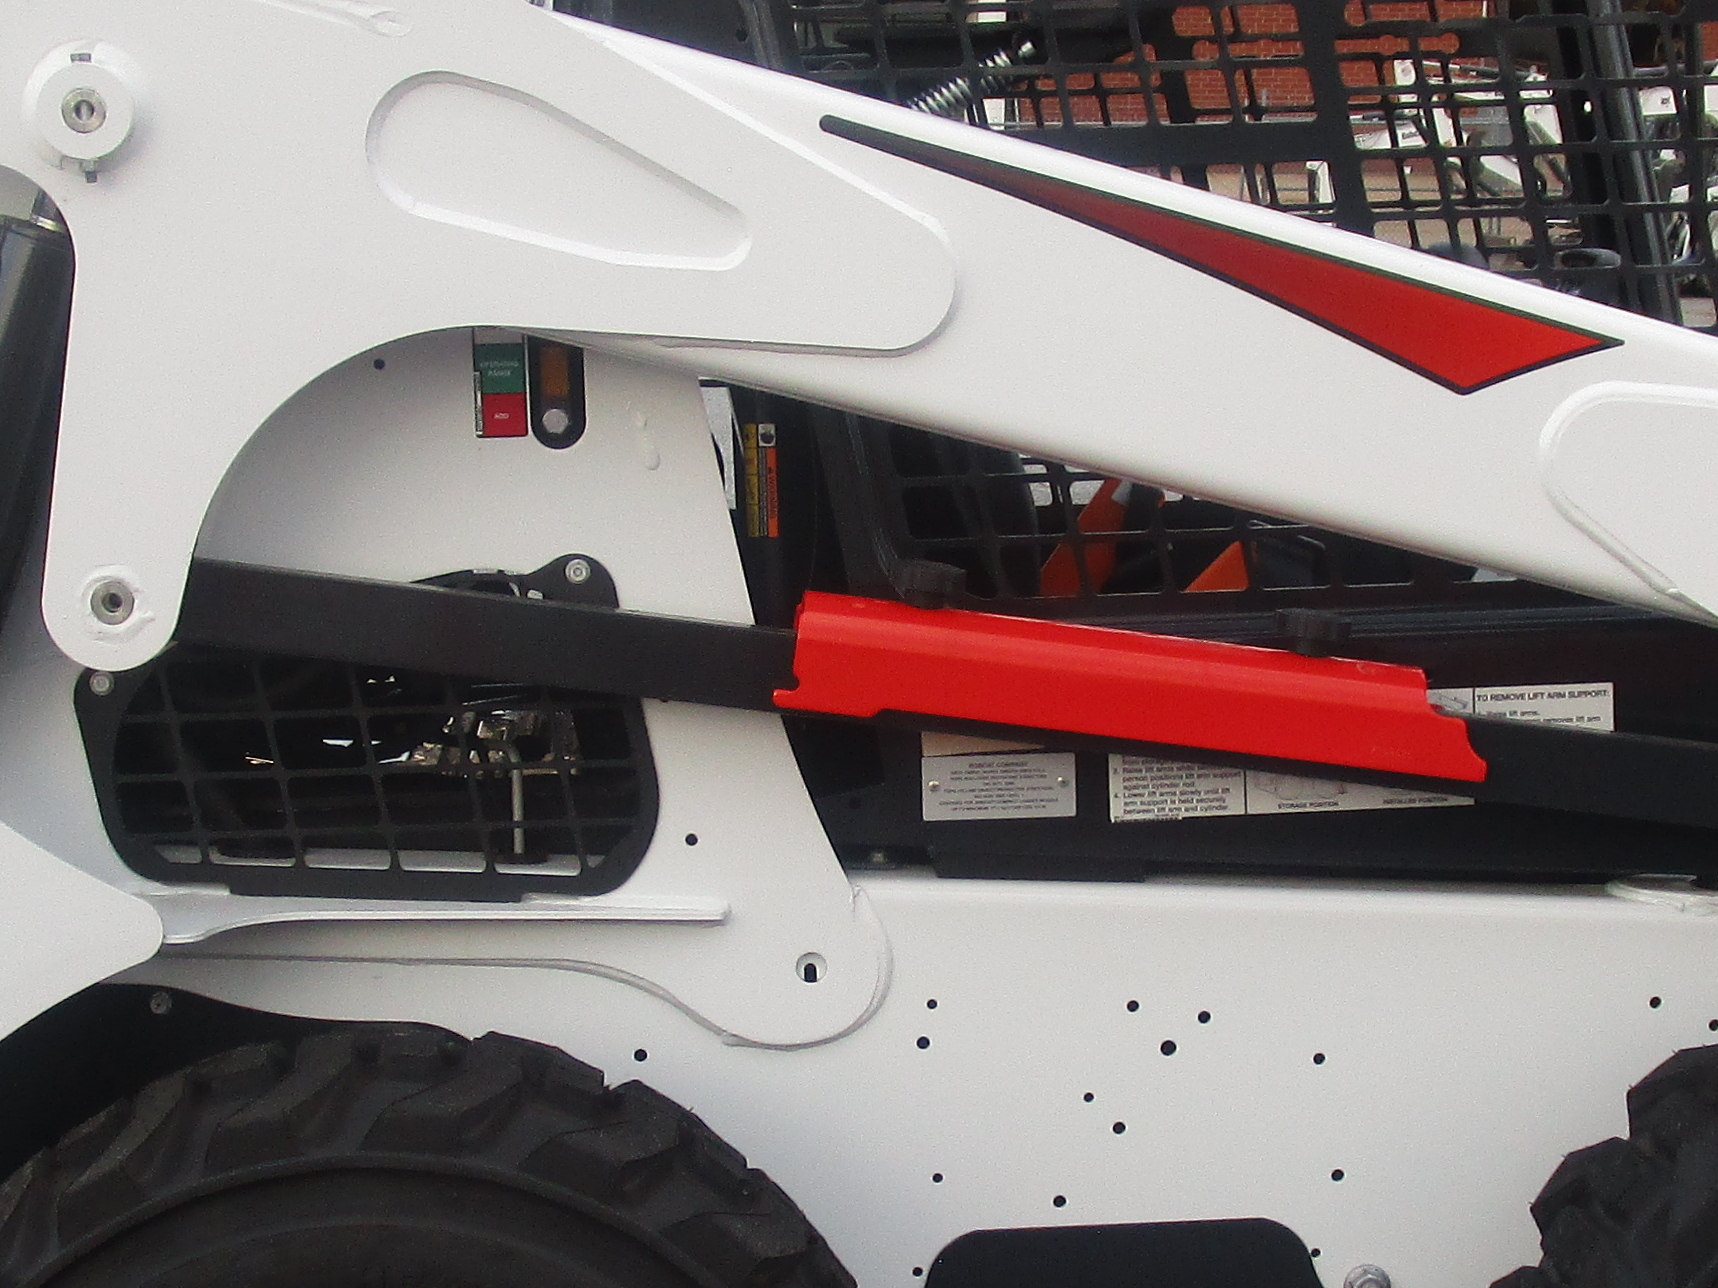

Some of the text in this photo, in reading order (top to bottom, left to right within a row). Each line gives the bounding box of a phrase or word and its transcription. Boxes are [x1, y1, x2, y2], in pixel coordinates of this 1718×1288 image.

[1477, 693, 1489, 701] TO
[1490, 693, 1527, 701] REMOVE
[1528, 692, 1546, 700] LIFT
[1547, 691, 1566, 699] ARM
